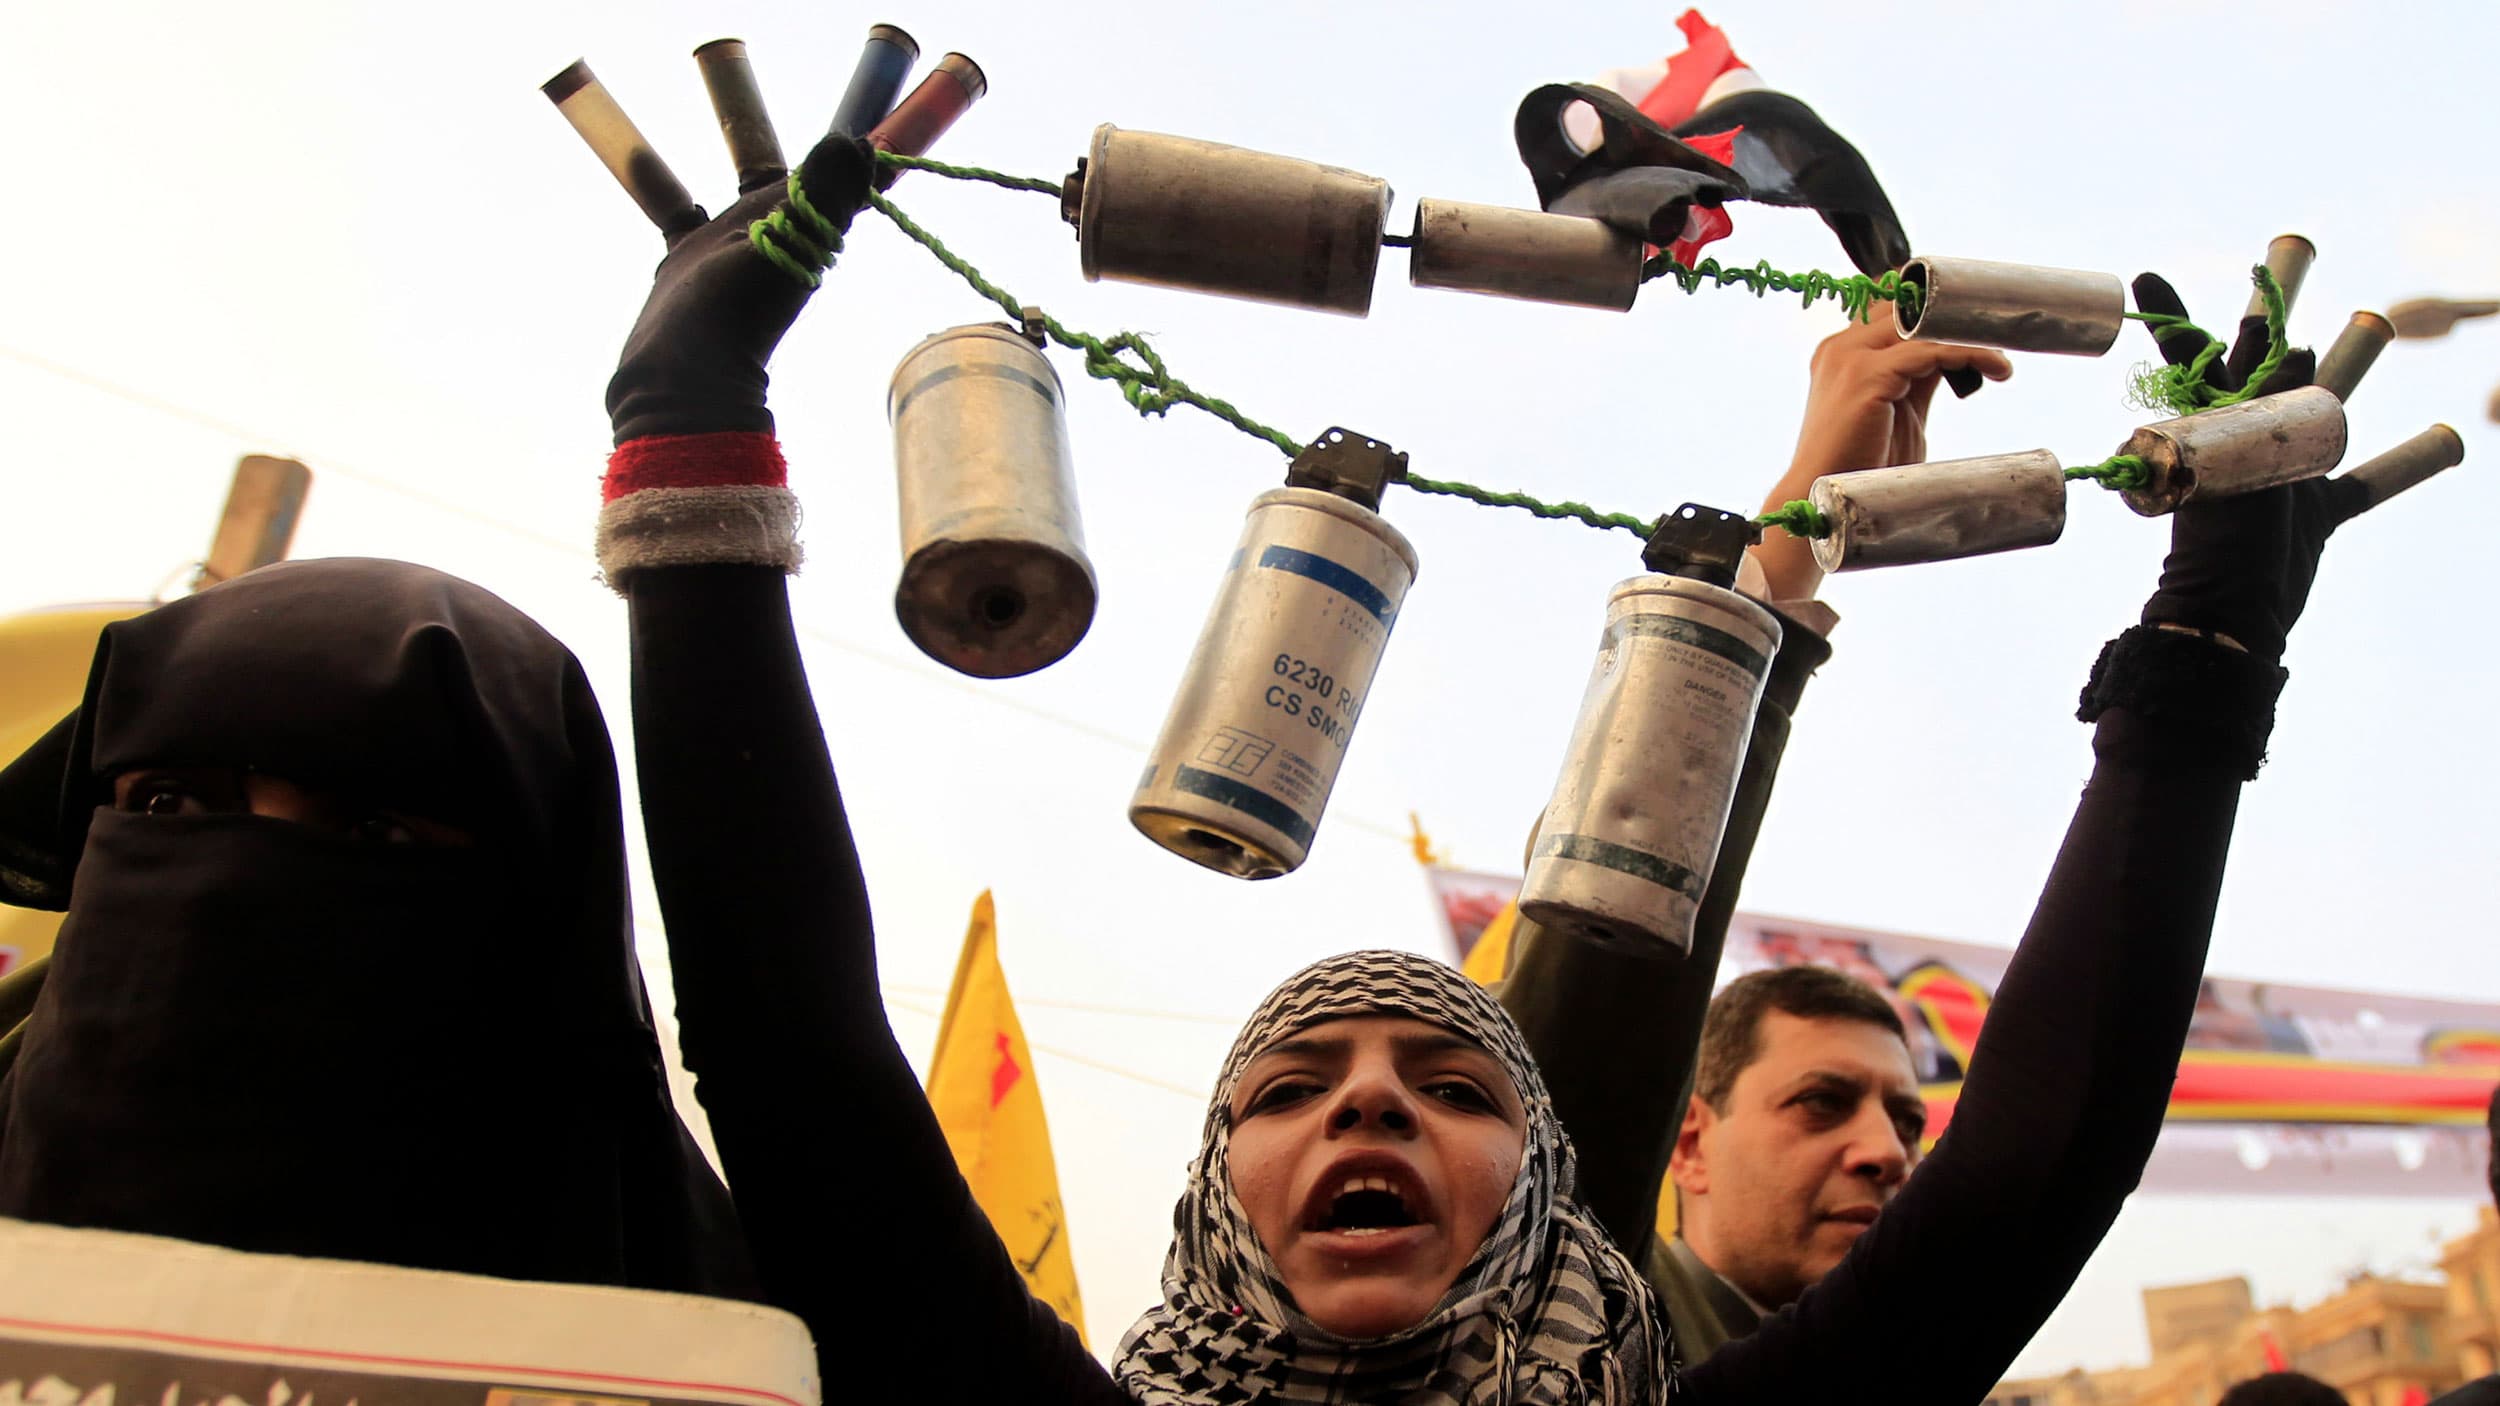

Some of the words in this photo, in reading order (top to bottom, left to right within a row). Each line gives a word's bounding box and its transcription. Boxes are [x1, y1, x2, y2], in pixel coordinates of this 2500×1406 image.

[1274, 653, 1334, 698] 6230
[1684, 679, 1727, 701] DANGER
[1265, 685, 1302, 716] CS
[1307, 705, 1347, 748] SMO
